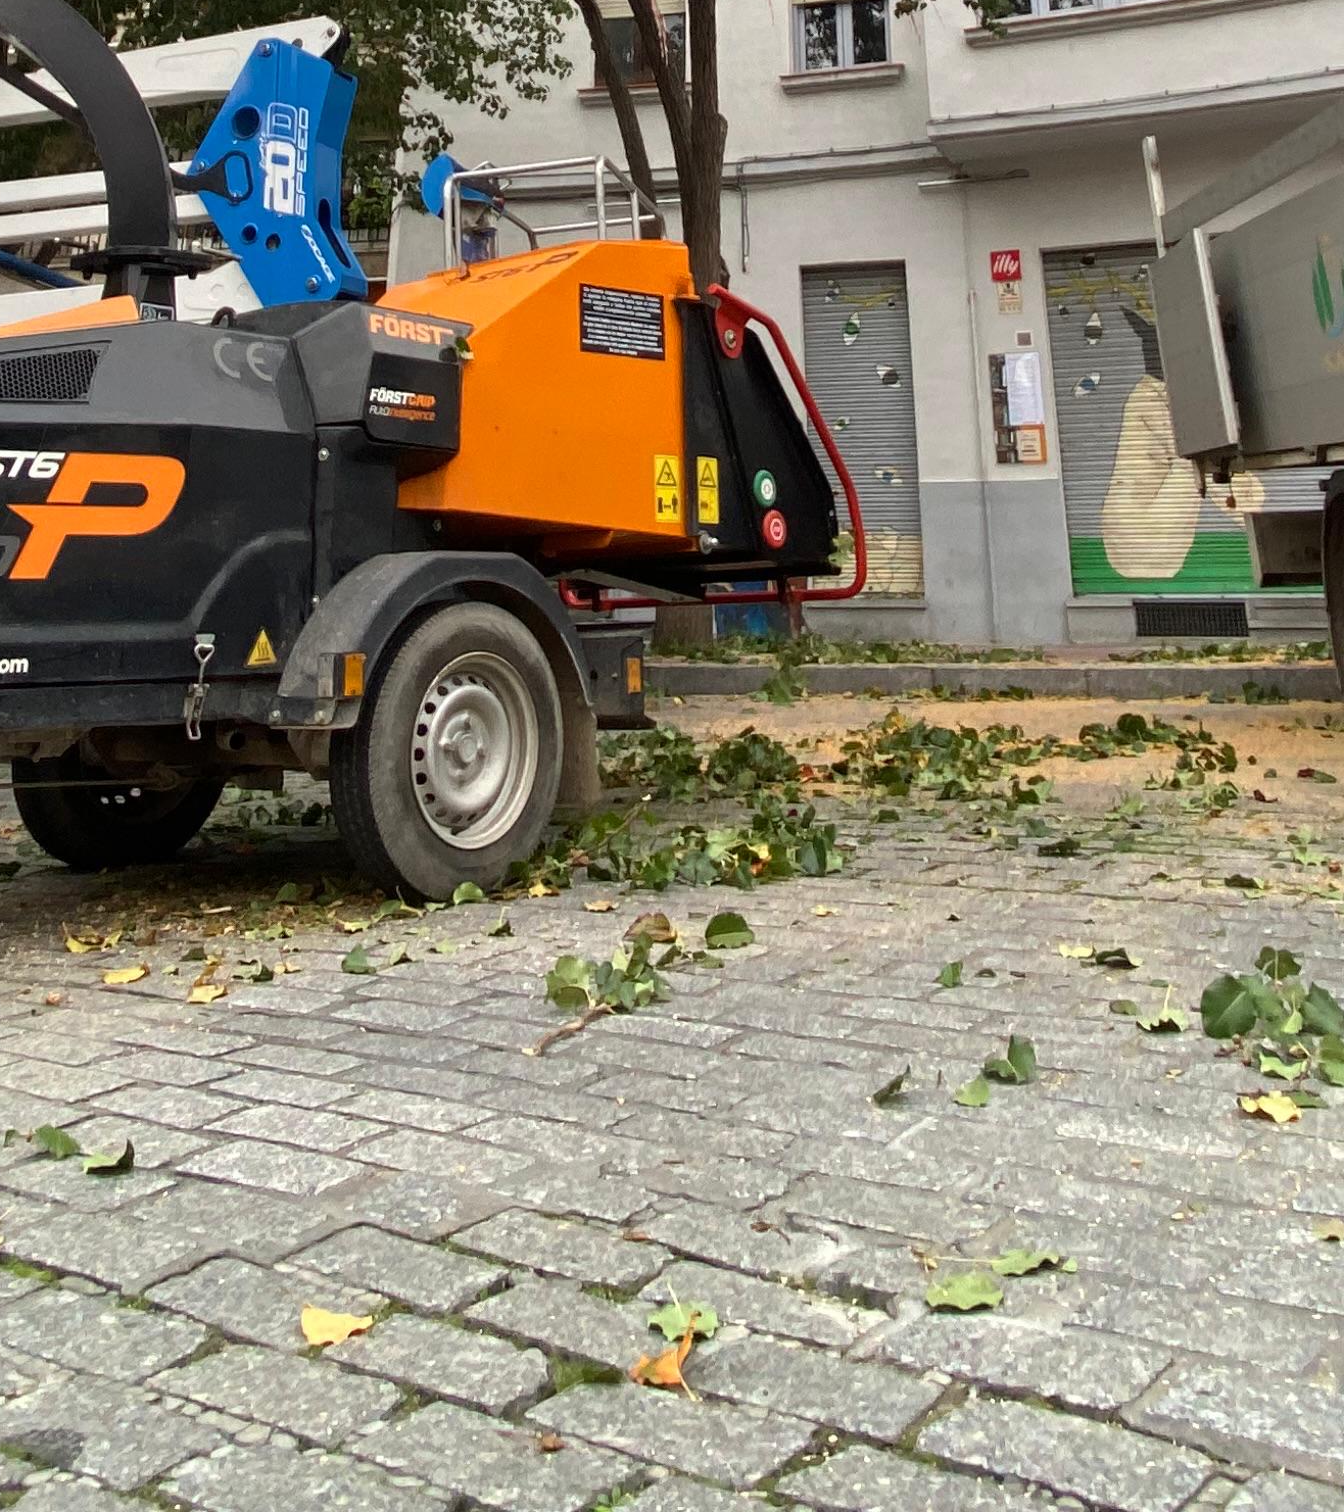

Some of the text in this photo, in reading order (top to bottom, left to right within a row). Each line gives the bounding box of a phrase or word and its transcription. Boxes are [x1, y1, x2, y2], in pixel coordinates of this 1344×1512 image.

[295, 107, 309, 217] SPEED
[993, 253, 1019, 276] illy
[368, 312, 454, 345] FÖRST
